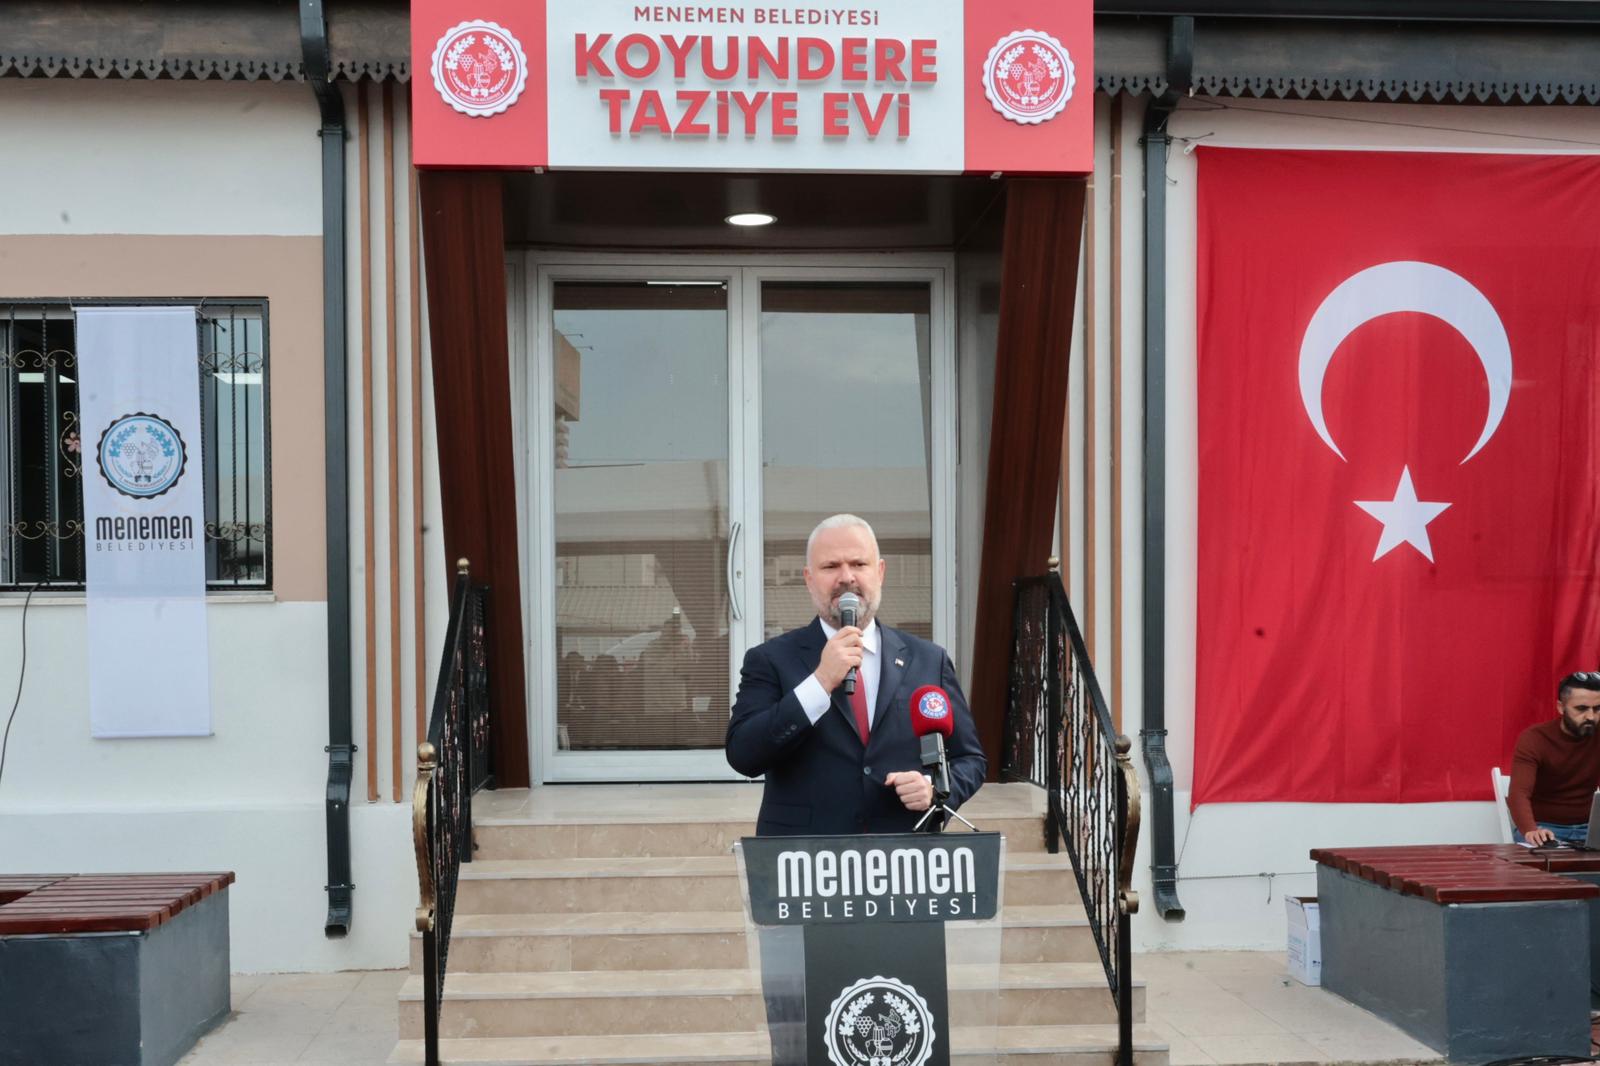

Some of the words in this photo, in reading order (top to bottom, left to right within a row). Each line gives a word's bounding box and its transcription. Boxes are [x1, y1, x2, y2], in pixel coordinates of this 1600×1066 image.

[634, 6, 745, 24] MENEMEN
[575, 33, 938, 83] KOYUNDERE
[599, 89, 799, 137] TAZİYE
[822, 92, 910, 138] EVİ
[96, 516, 193, 540] menemen
[777, 847, 976, 897] menemen
[778, 894, 977, 919] BELEDİYESİ
